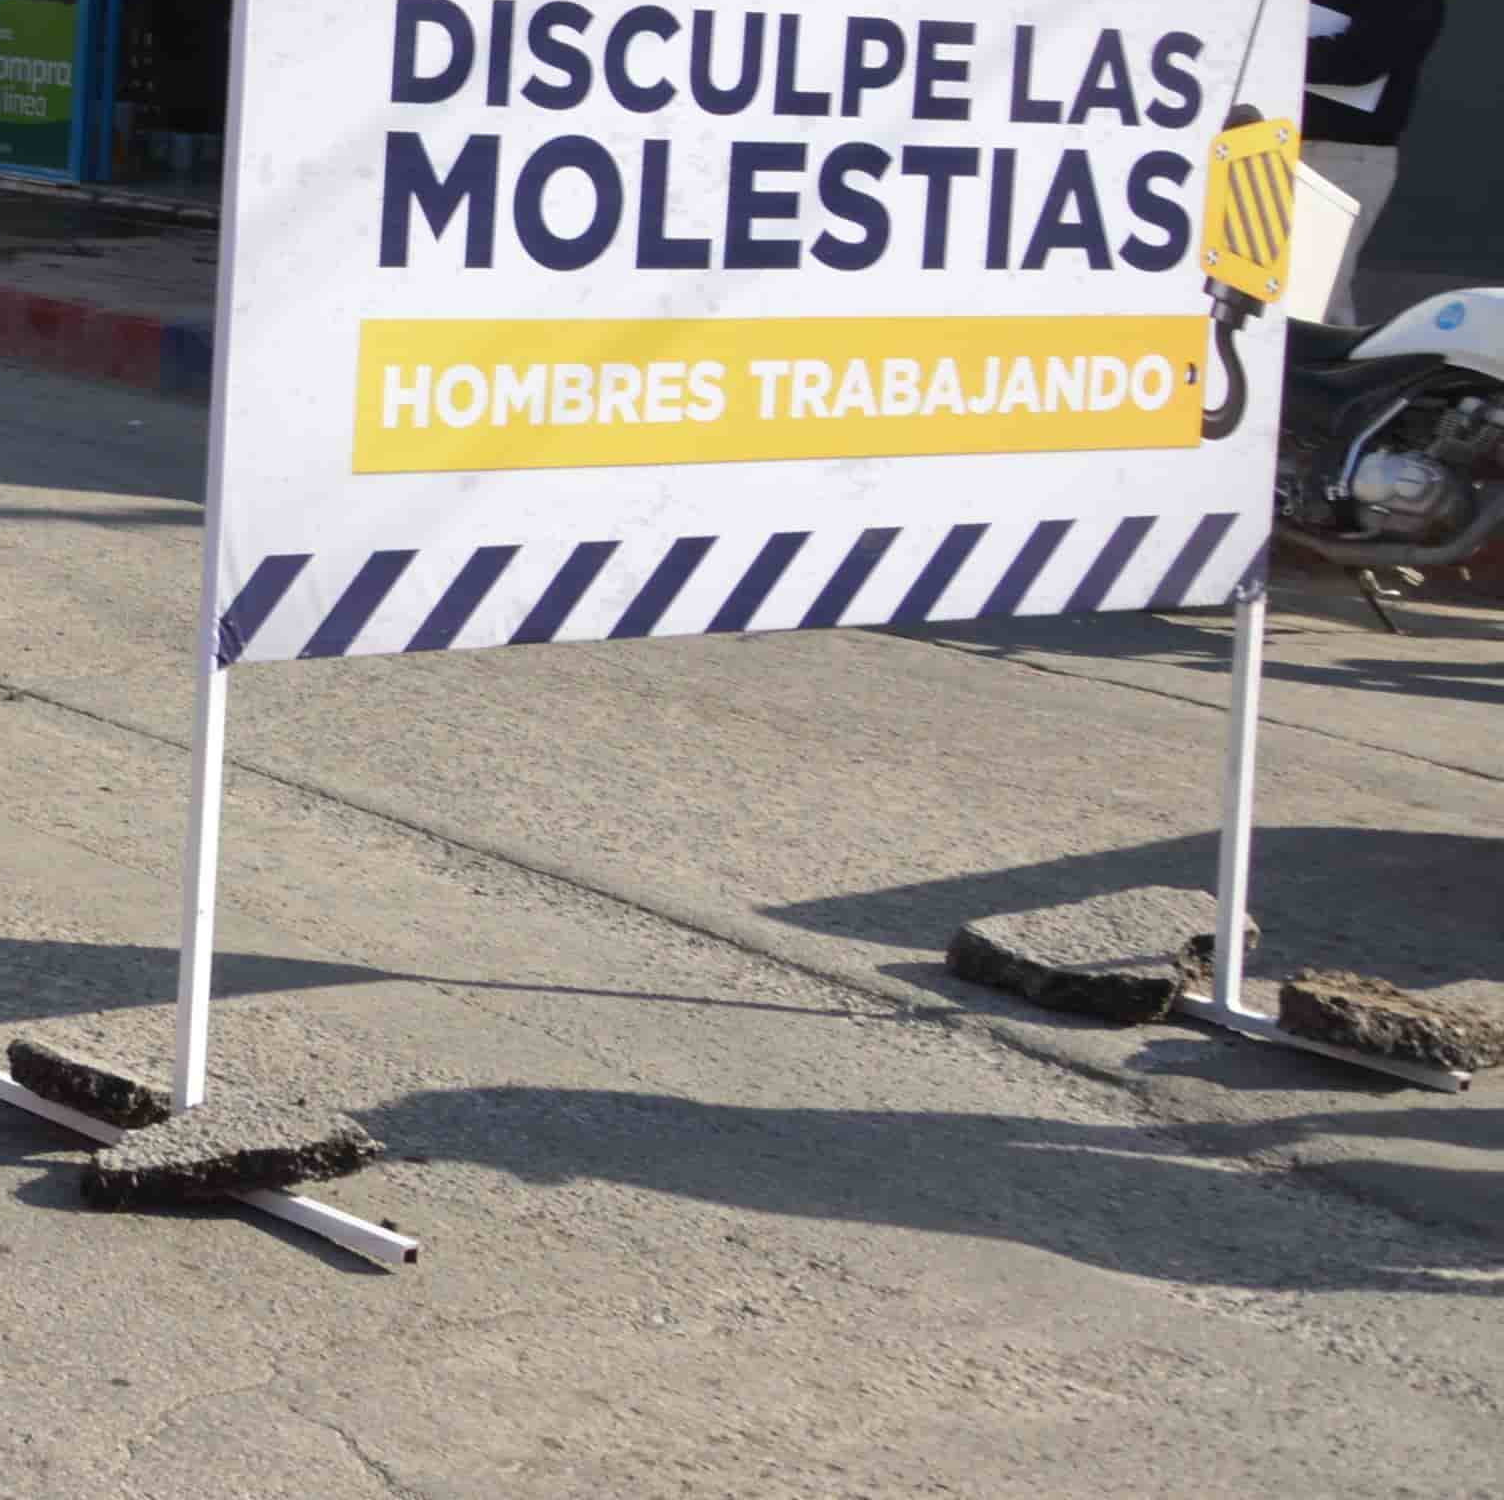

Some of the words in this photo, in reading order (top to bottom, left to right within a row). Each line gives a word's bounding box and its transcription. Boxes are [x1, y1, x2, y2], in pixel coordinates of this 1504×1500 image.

[1008, 24, 1205, 130] LAS
[378, 130, 1195, 273] MOLESTIAS
[382, 361, 727, 430] HOMBRES
[748, 354, 1177, 421] TRABAJANDO
